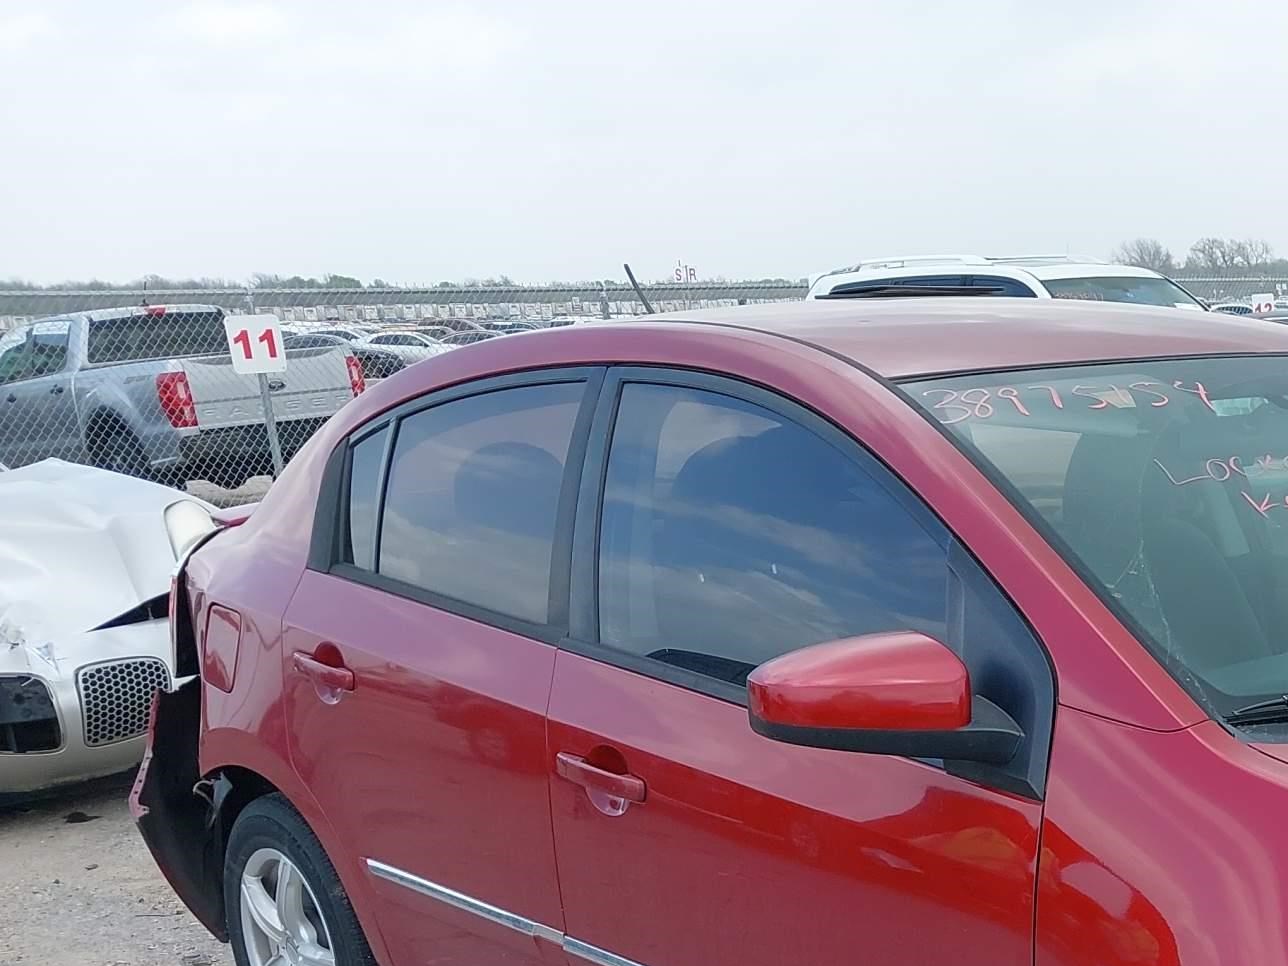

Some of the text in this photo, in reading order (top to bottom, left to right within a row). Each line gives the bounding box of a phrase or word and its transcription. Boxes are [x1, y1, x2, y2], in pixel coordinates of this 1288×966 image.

[675, 268, 682, 281] S
[689, 268, 697, 281] R
[233, 328, 278, 360] 11
